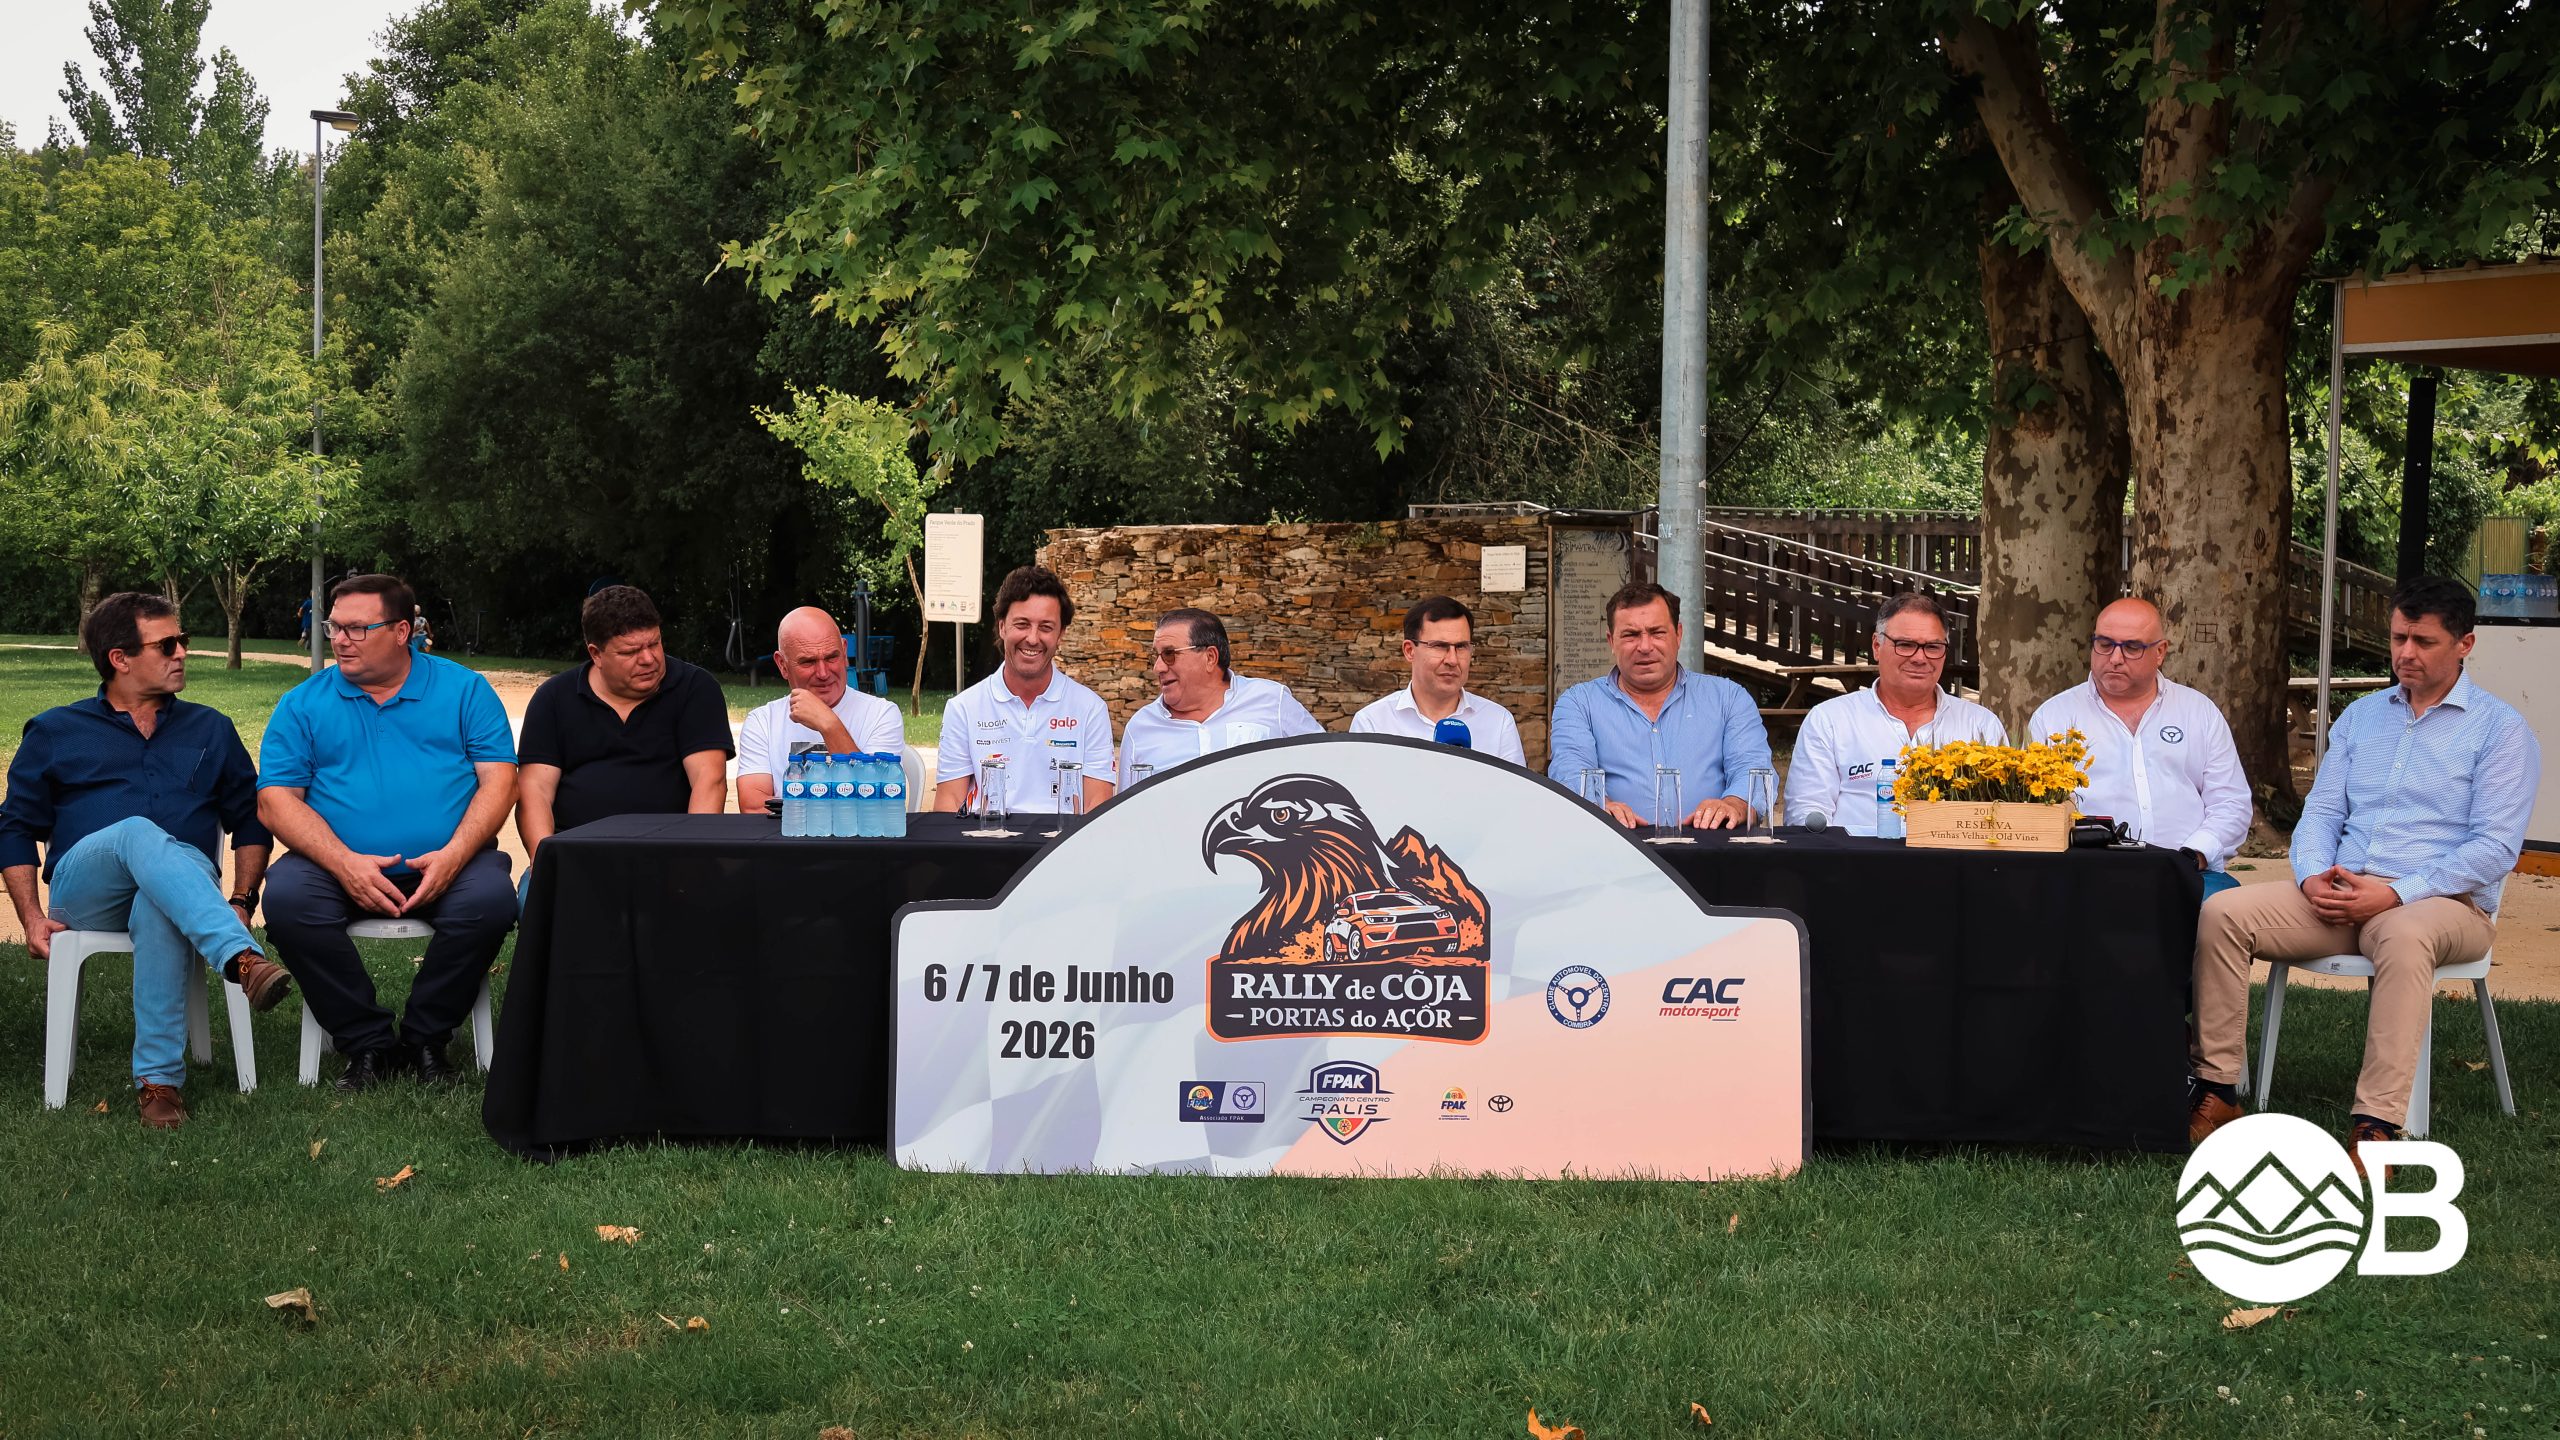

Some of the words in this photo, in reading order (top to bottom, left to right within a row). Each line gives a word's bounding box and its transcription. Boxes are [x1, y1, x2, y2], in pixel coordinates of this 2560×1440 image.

[1050, 717, 1077, 730] galp
[1848, 762, 1874, 776] CAC
[1956, 820, 2012, 830] RESERVA
[1930, 831, 1960, 839] Vinhas
[1962, 832, 1988, 840] Velhas
[1996, 832, 2013, 841] Old
[924, 963, 947, 1002] 6
[956, 963, 975, 1002] /
[982, 964, 1001, 1002] 7
[1009, 964, 1055, 1002] de
[1064, 964, 1174, 1004] Junho
[1231, 972, 1342, 1000] RALLY
[1345, 979, 1375, 1000] de
[1662, 977, 1746, 1004] CAC
[1548, 985, 1556, 1010] CLUBE
[1592, 972, 1604, 983] DO
[1600, 982, 1610, 1013] CENTRO
[1250, 1007, 1345, 1027] PORTAS
[1350, 1009, 1377, 1028] do
[1659, 1006, 1741, 1019] motorsport
[1000, 1020, 1096, 1060] 2026
[1321, 1073, 1368, 1089] FPAK
[1310, 1103, 1379, 1115] RALIS
[1440, 1100, 1468, 1110] FPAK
